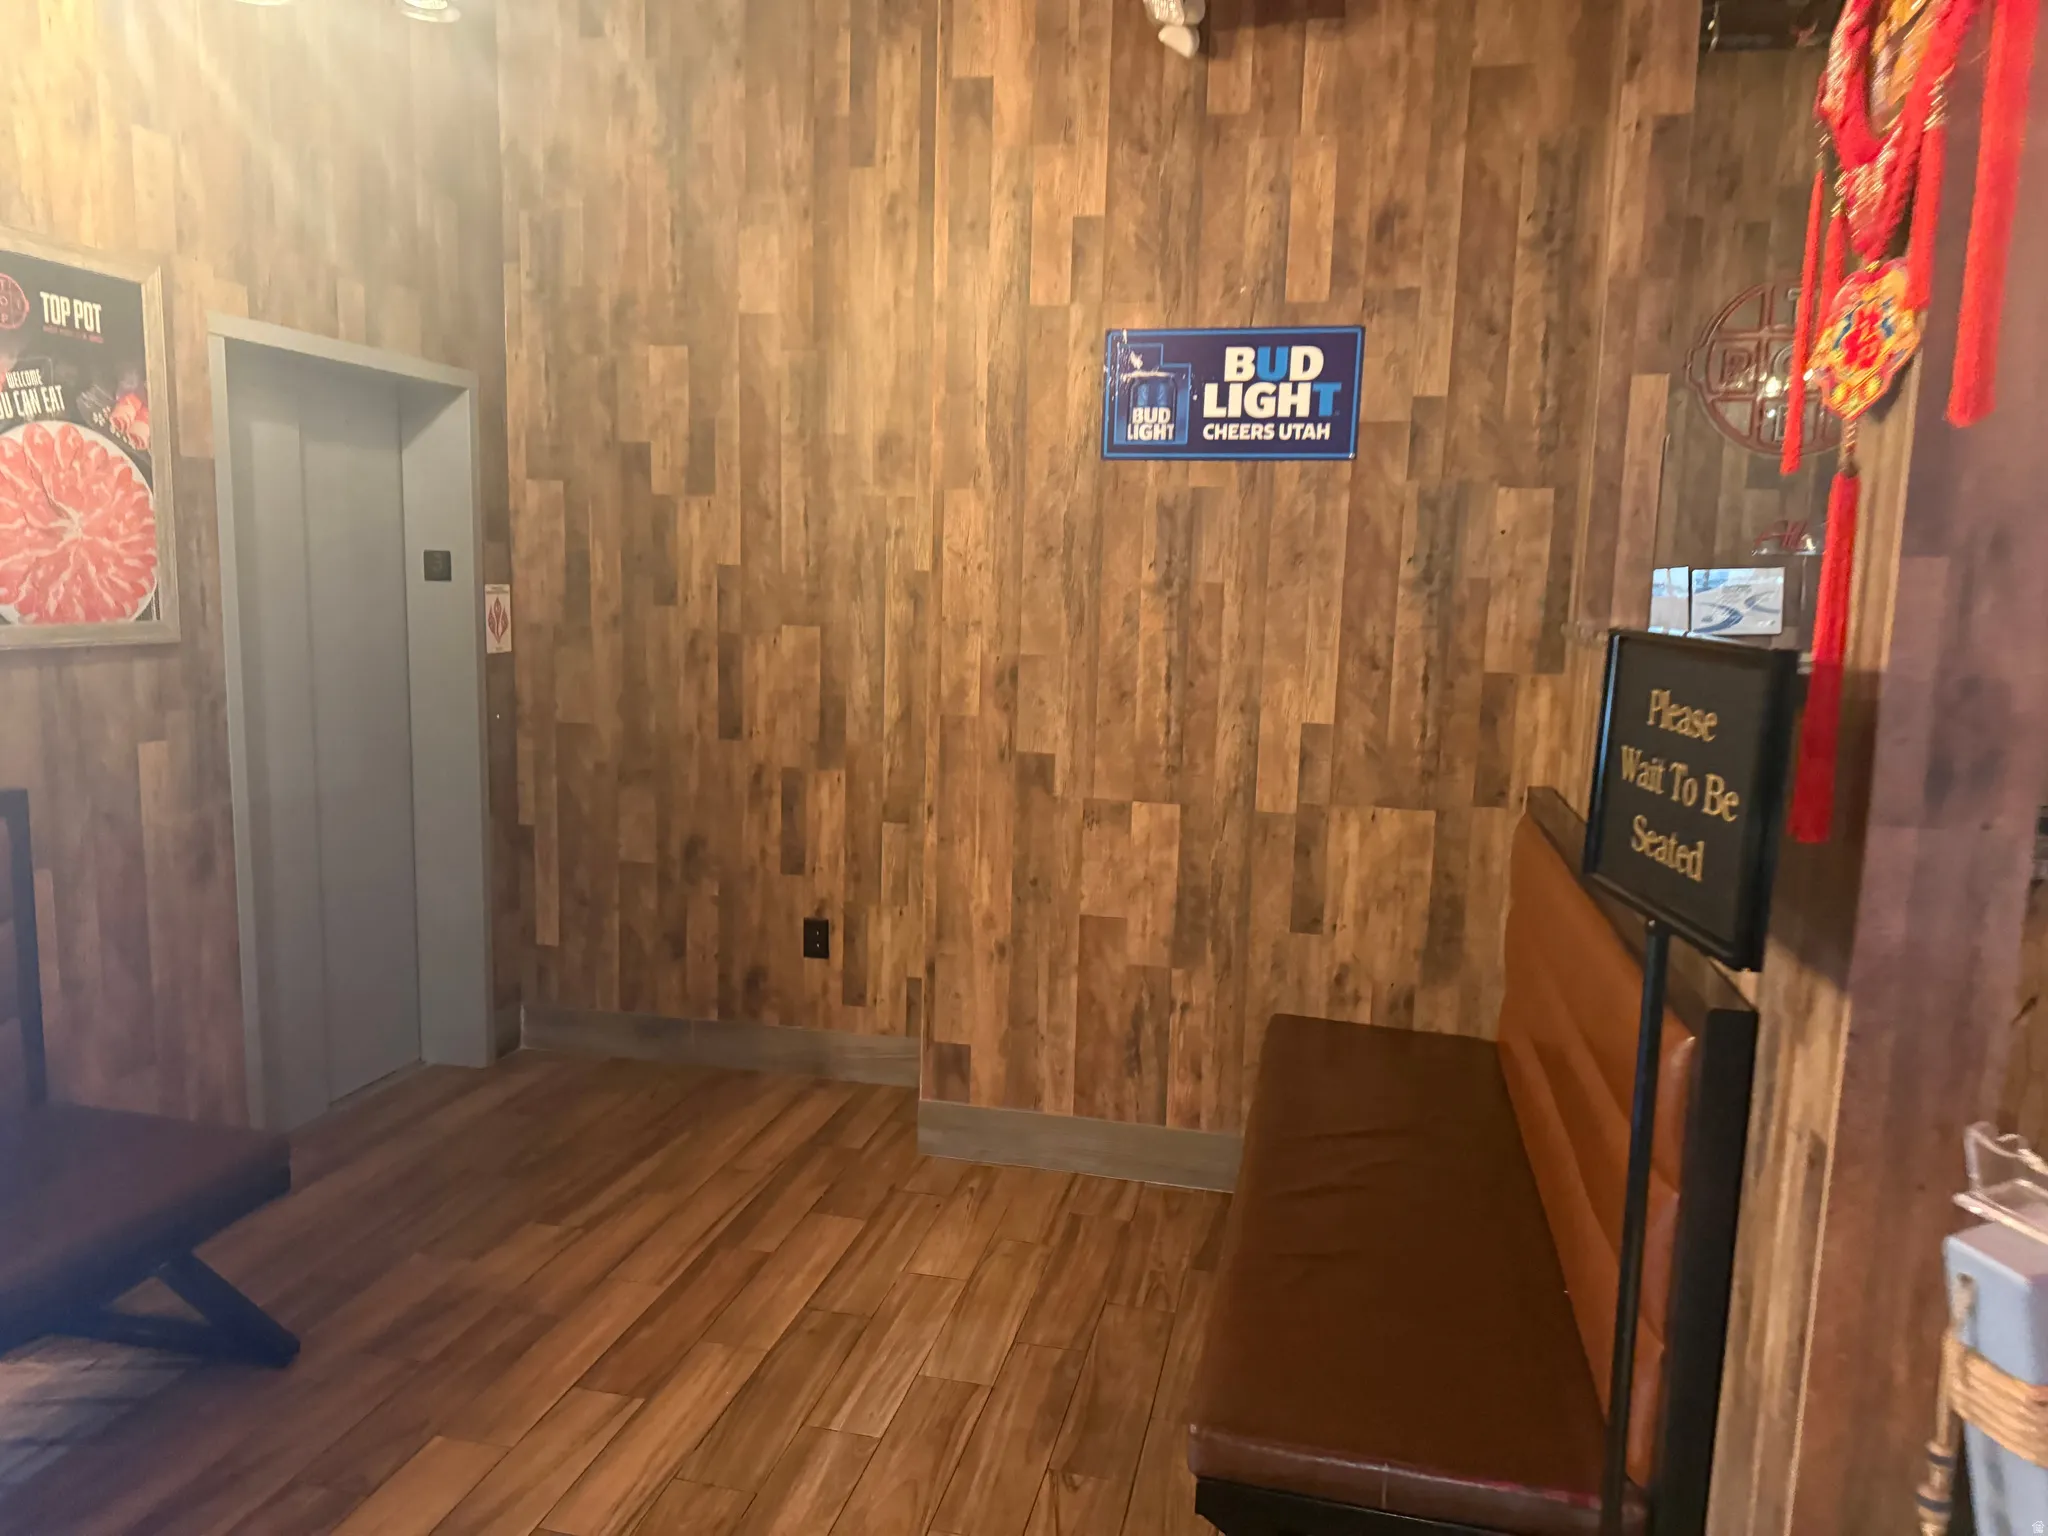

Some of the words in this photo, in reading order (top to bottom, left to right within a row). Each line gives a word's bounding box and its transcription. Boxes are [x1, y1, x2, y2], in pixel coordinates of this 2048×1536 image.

[39, 290, 71, 327] TOP
[73, 298, 102, 333] POT
[5, 368, 43, 389] WELCOME
[1223, 345, 1324, 382] BUD
[13, 388, 42, 417] CAN
[40, 384, 65, 413] EAT
[1132, 407, 1171, 424] BUD
[1203, 382, 1342, 418] LIGHT
[1127, 423, 1174, 441] LIGHT
[1202, 423, 1275, 441] CHEERS
[1278, 422, 1331, 441] UTAH
[1646, 688, 1718, 742] Please
[1621, 744, 1665, 795] Wait
[1668, 761, 1699, 808] To
[1702, 772, 1740, 823] Be
[1631, 814, 1705, 883] Seated
